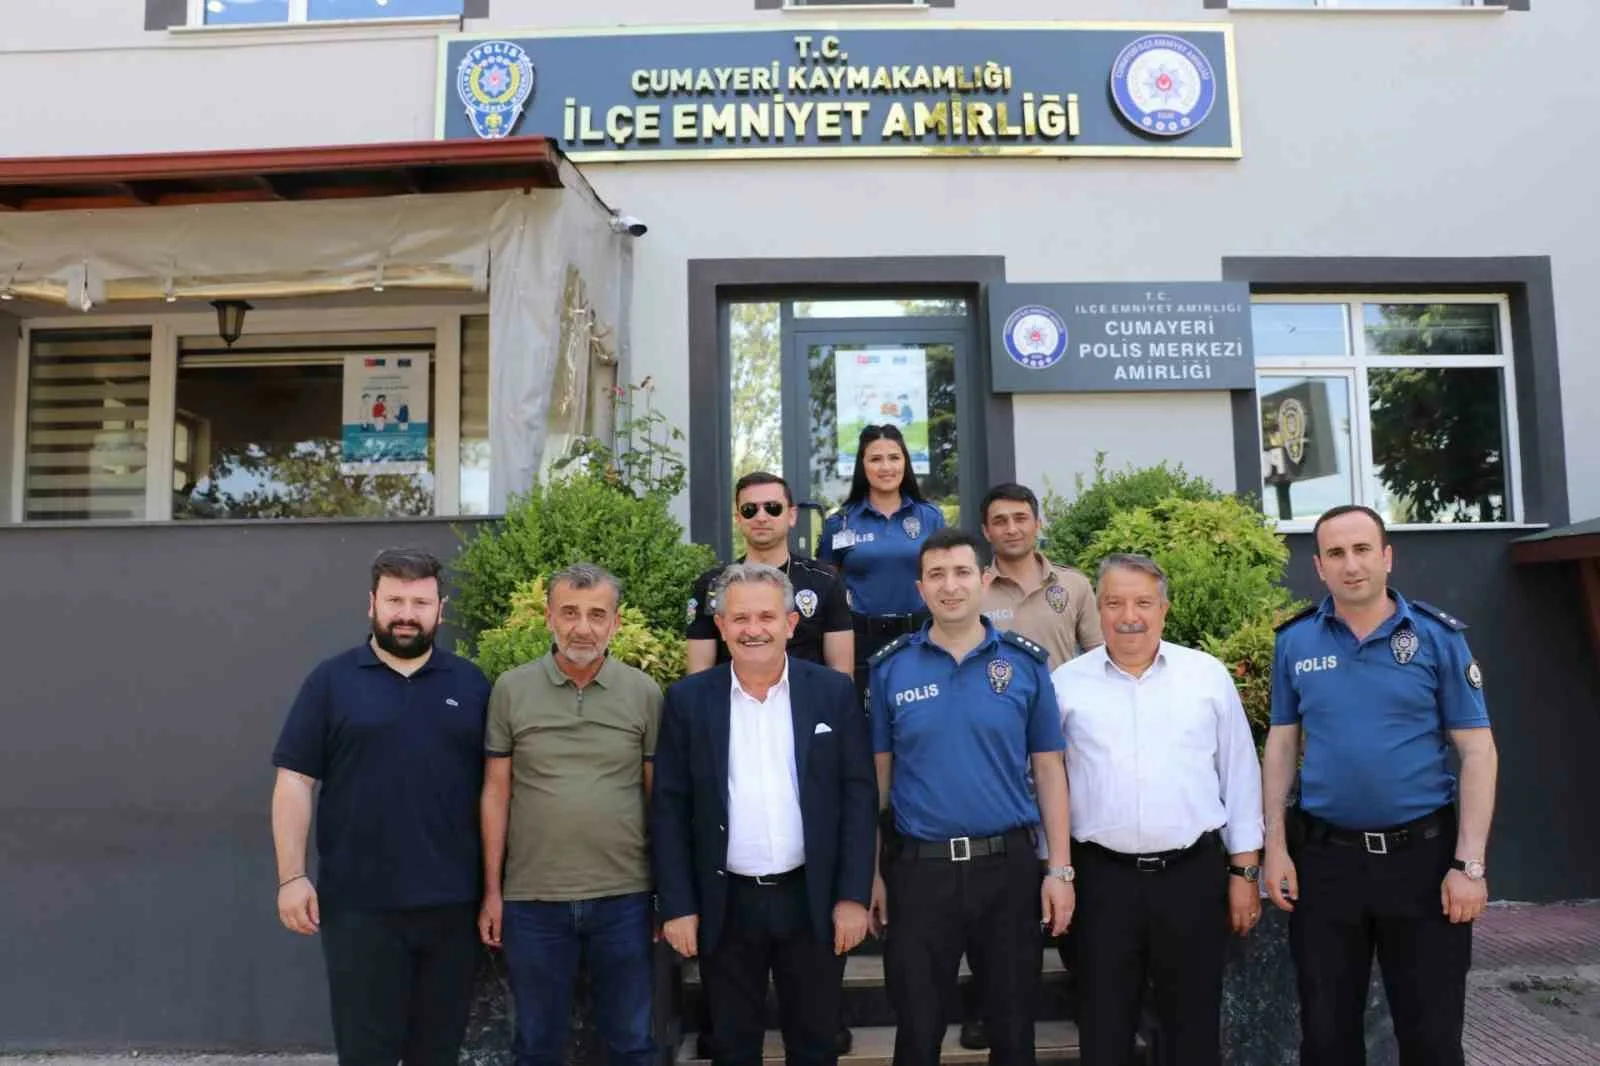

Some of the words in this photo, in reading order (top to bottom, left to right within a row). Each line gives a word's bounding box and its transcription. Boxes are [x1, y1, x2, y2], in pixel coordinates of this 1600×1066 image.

[794, 35, 848, 58] T.C.
[631, 60, 780, 93] CUMAYERİ
[787, 61, 1012, 90] KAYMAKAMLIĞI
[563, 97, 661, 143] İLÇE
[673, 93, 870, 138] EMNİYET
[882, 92, 1080, 137] AMİRLİĞİ
[1105, 315, 1215, 336] CUMAYERİ
[1079, 338, 1142, 358] POLİS
[1149, 337, 1243, 358] MERKEZİ
[1114, 359, 1212, 381] AMİRLİĞİ
